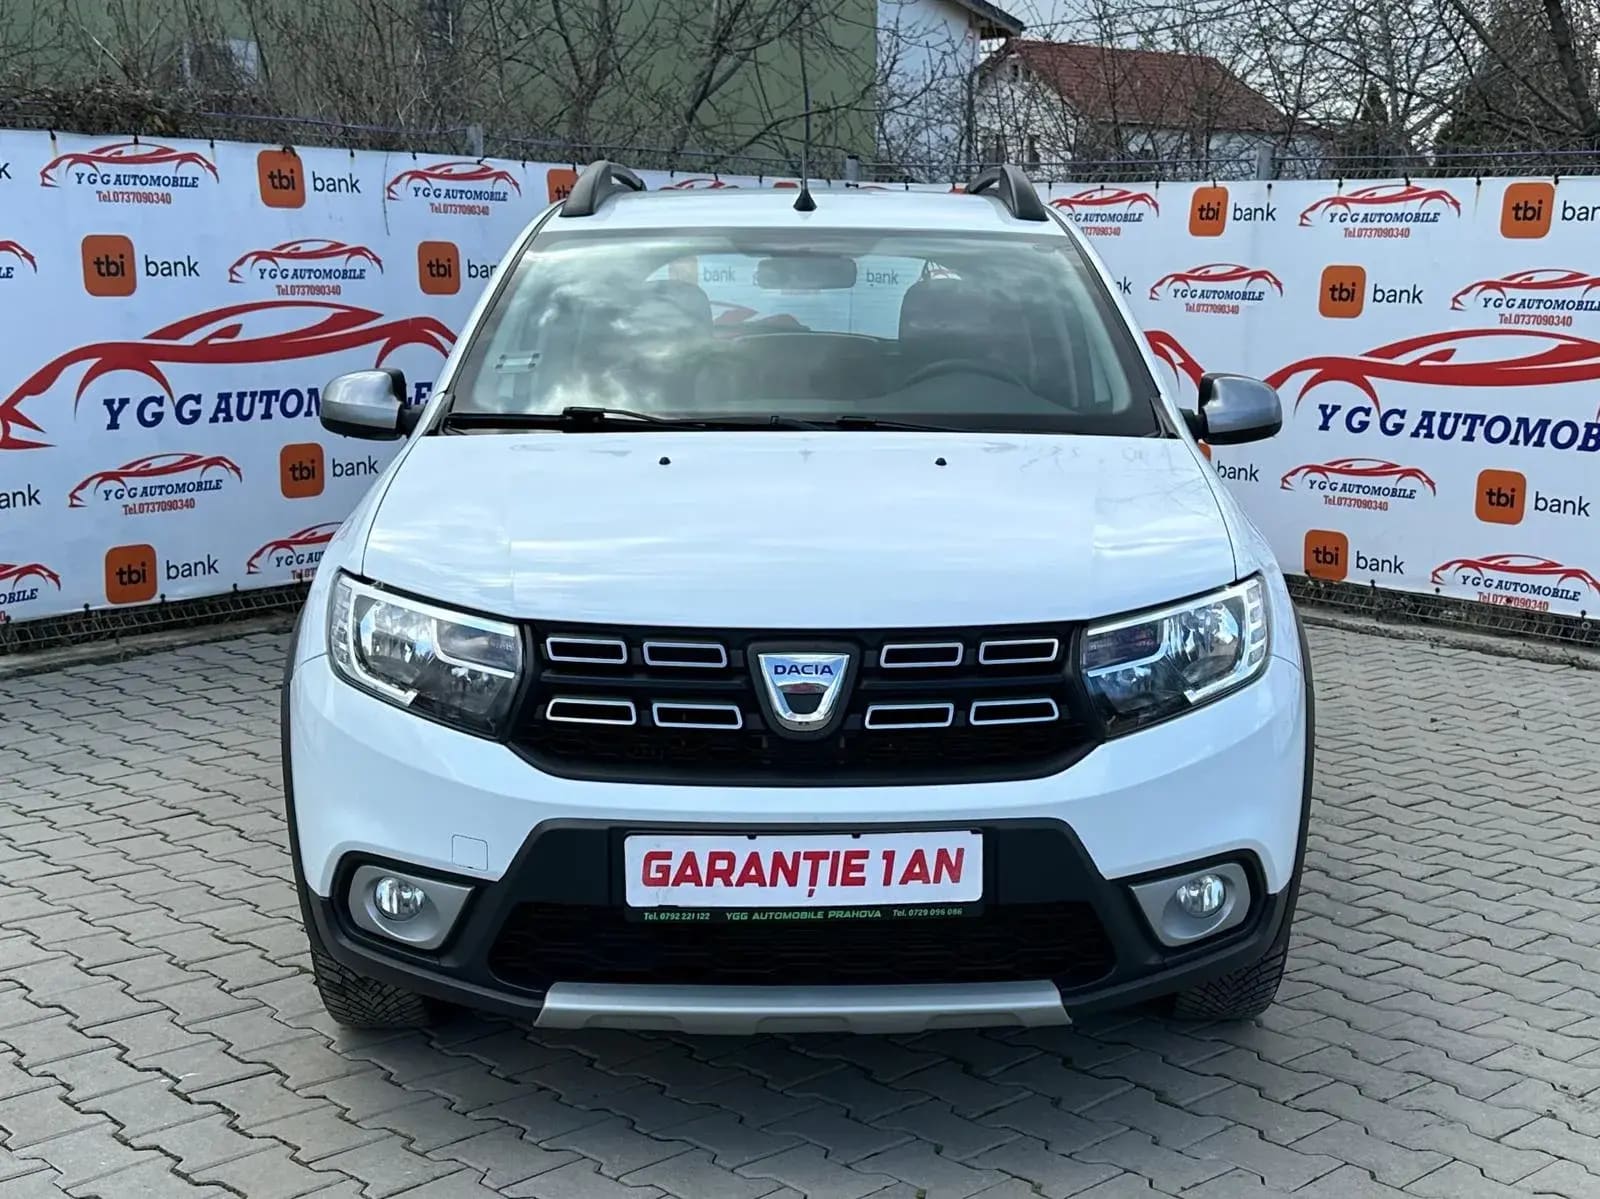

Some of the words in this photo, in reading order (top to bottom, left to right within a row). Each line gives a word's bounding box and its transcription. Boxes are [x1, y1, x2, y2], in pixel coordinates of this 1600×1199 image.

[113, 174, 199, 188] AUTOMOBILE
[267, 169, 296, 191] tbi
[312, 171, 361, 194] bank
[443, 189, 509, 202] AUTOMOBILE
[1082, 213, 1144, 223] AUTOMOBILE
[1197, 202, 1221, 221] tbi
[1233, 203, 1277, 223] bank
[1360, 212, 1441, 224] AUTOMOBILE
[1511, 199, 1543, 221] tbi
[93, 254, 125, 277] tbi
[145, 254, 200, 277] bank
[291, 268, 367, 280] AUTOMOBILE
[427, 258, 452, 278] tbi
[866, 269, 899, 285] bank
[1198, 289, 1265, 301] AUTOMOBILE
[1329, 282, 1356, 303] tbi
[1372, 284, 1424, 304] bank
[289, 459, 316, 481] tbi
[332, 455, 379, 478] bank
[1217, 460, 1260, 482] bank
[140, 479, 223, 498] AUTOMOBILE
[1339, 483, 1417, 499] AUTOMOBILE
[1485, 487, 1515, 509] tbi
[1533, 491, 1591, 517] bank
[116, 562, 146, 586] tbi
[166, 554, 220, 580] bank
[1312, 545, 1339, 566] tbi
[1355, 551, 1404, 575] bank
[1495, 580, 1581, 601] AUTOMOBILE
[773, 663, 835, 676] DACIA
[641, 849, 870, 898] GARANȚIE
[725, 911, 749, 921] YGG
[752, 910, 824, 920] AUTOMOBILE
[828, 909, 882, 920] PRAHOVA
